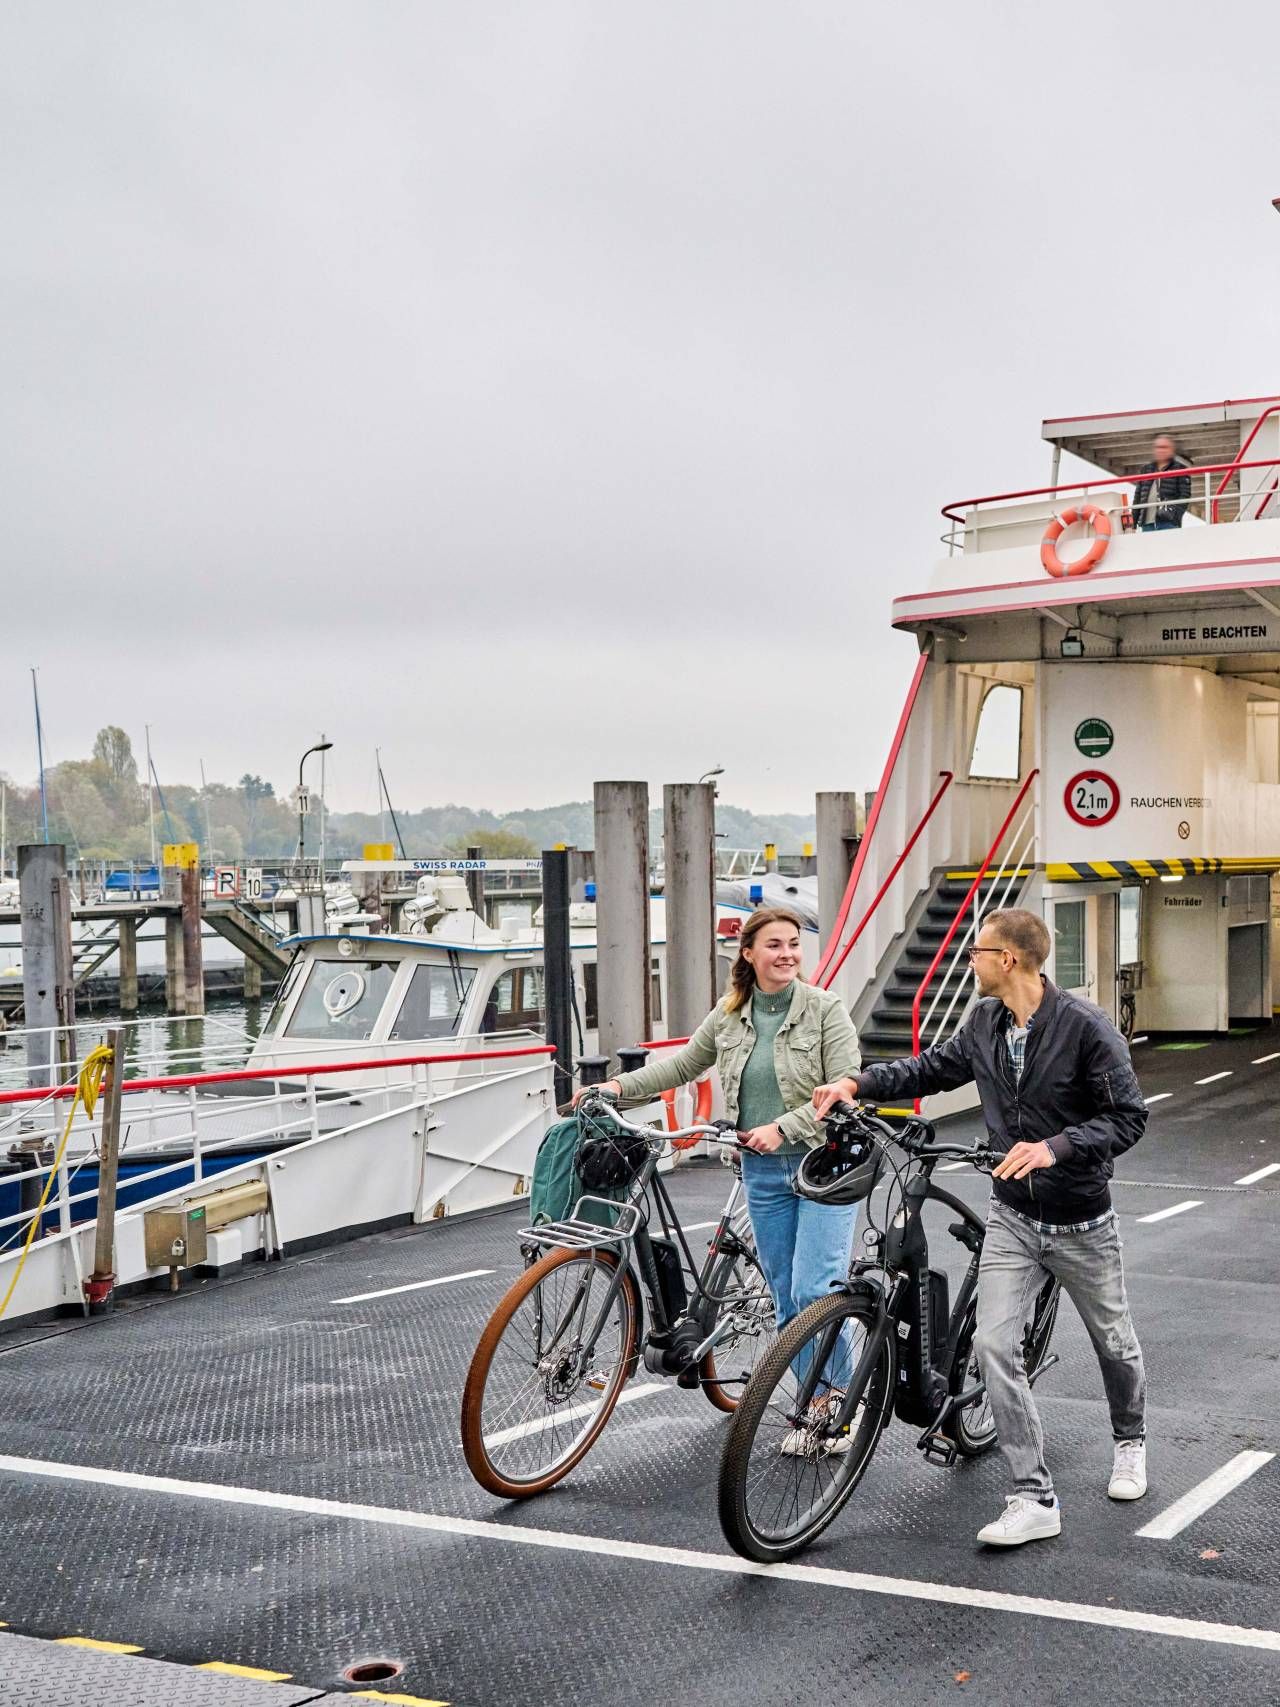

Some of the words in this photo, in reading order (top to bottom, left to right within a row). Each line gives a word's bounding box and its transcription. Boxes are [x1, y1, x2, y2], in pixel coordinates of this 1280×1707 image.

[1162, 628, 1196, 641] BITTE
[1202, 625, 1267, 640] BEACHTEN
[299, 795, 308, 811] 11
[1130, 797, 1182, 808] RAUCHEN
[413, 861, 447, 870] SWISS
[450, 861, 487, 869] RADAR
[248, 879, 261, 896] 10
[1164, 896, 1202, 906] Fahrräder
